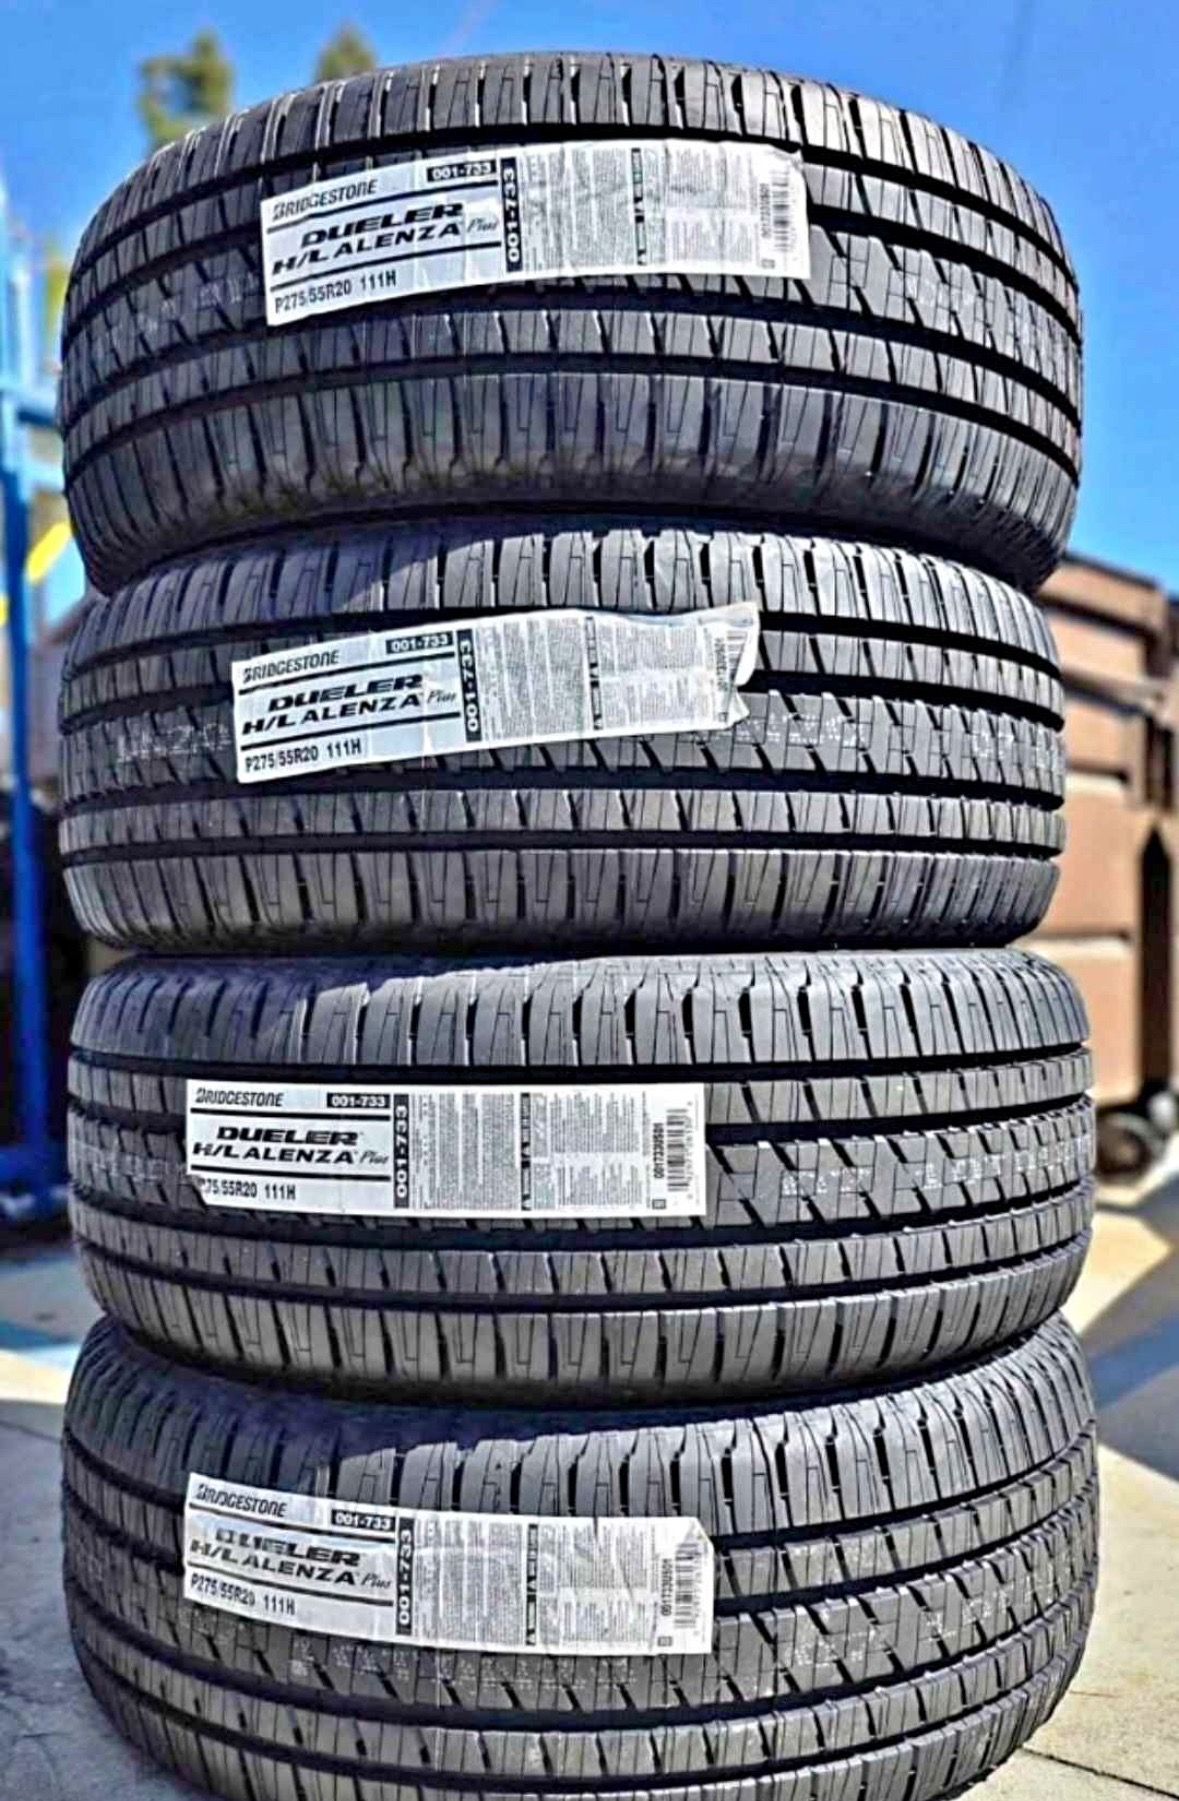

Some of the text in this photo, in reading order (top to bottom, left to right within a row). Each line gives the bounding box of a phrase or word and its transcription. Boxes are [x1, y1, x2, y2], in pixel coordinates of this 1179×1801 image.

[431, 163, 491, 180] 001-733
[273, 178, 379, 221] BRIDGESTONE
[502, 166, 521, 264] 001-733
[300, 203, 464, 248] DUELER
[332, 222, 461, 259] ALENZA
[467, 216, 499, 234] Plus
[360, 269, 397, 290] 111H
[390, 632, 449, 652] 001-733
[243, 650, 340, 683] BRIDGESTONE
[268, 674, 423, 712] DUELER
[459, 639, 481, 732] 001-733
[299, 693, 421, 725] ALENZA
[426, 689, 458, 705] Plus
[326, 738, 362, 759] 111H
[195, 1087, 284, 1107] BRIDGESTONE
[331, 1095, 385, 1108] 001-733
[216, 1126, 359, 1146] DUELER
[395, 1104, 409, 1199] 001-733
[242, 1147, 354, 1164] ALENZA
[359, 1149, 391, 1165] Plus
[264, 1183, 296, 1200] 111H
[196, 1483, 288, 1518] BRIDGESTONE
[334, 1513, 392, 1529] 001-733
[215, 1528, 361, 1567] DUELER
[241, 1554, 357, 1586] ALENZA
[361, 1572, 393, 1590] Plus
[397, 1529, 413, 1625] 001-733
[263, 1595, 296, 1615] 111H
